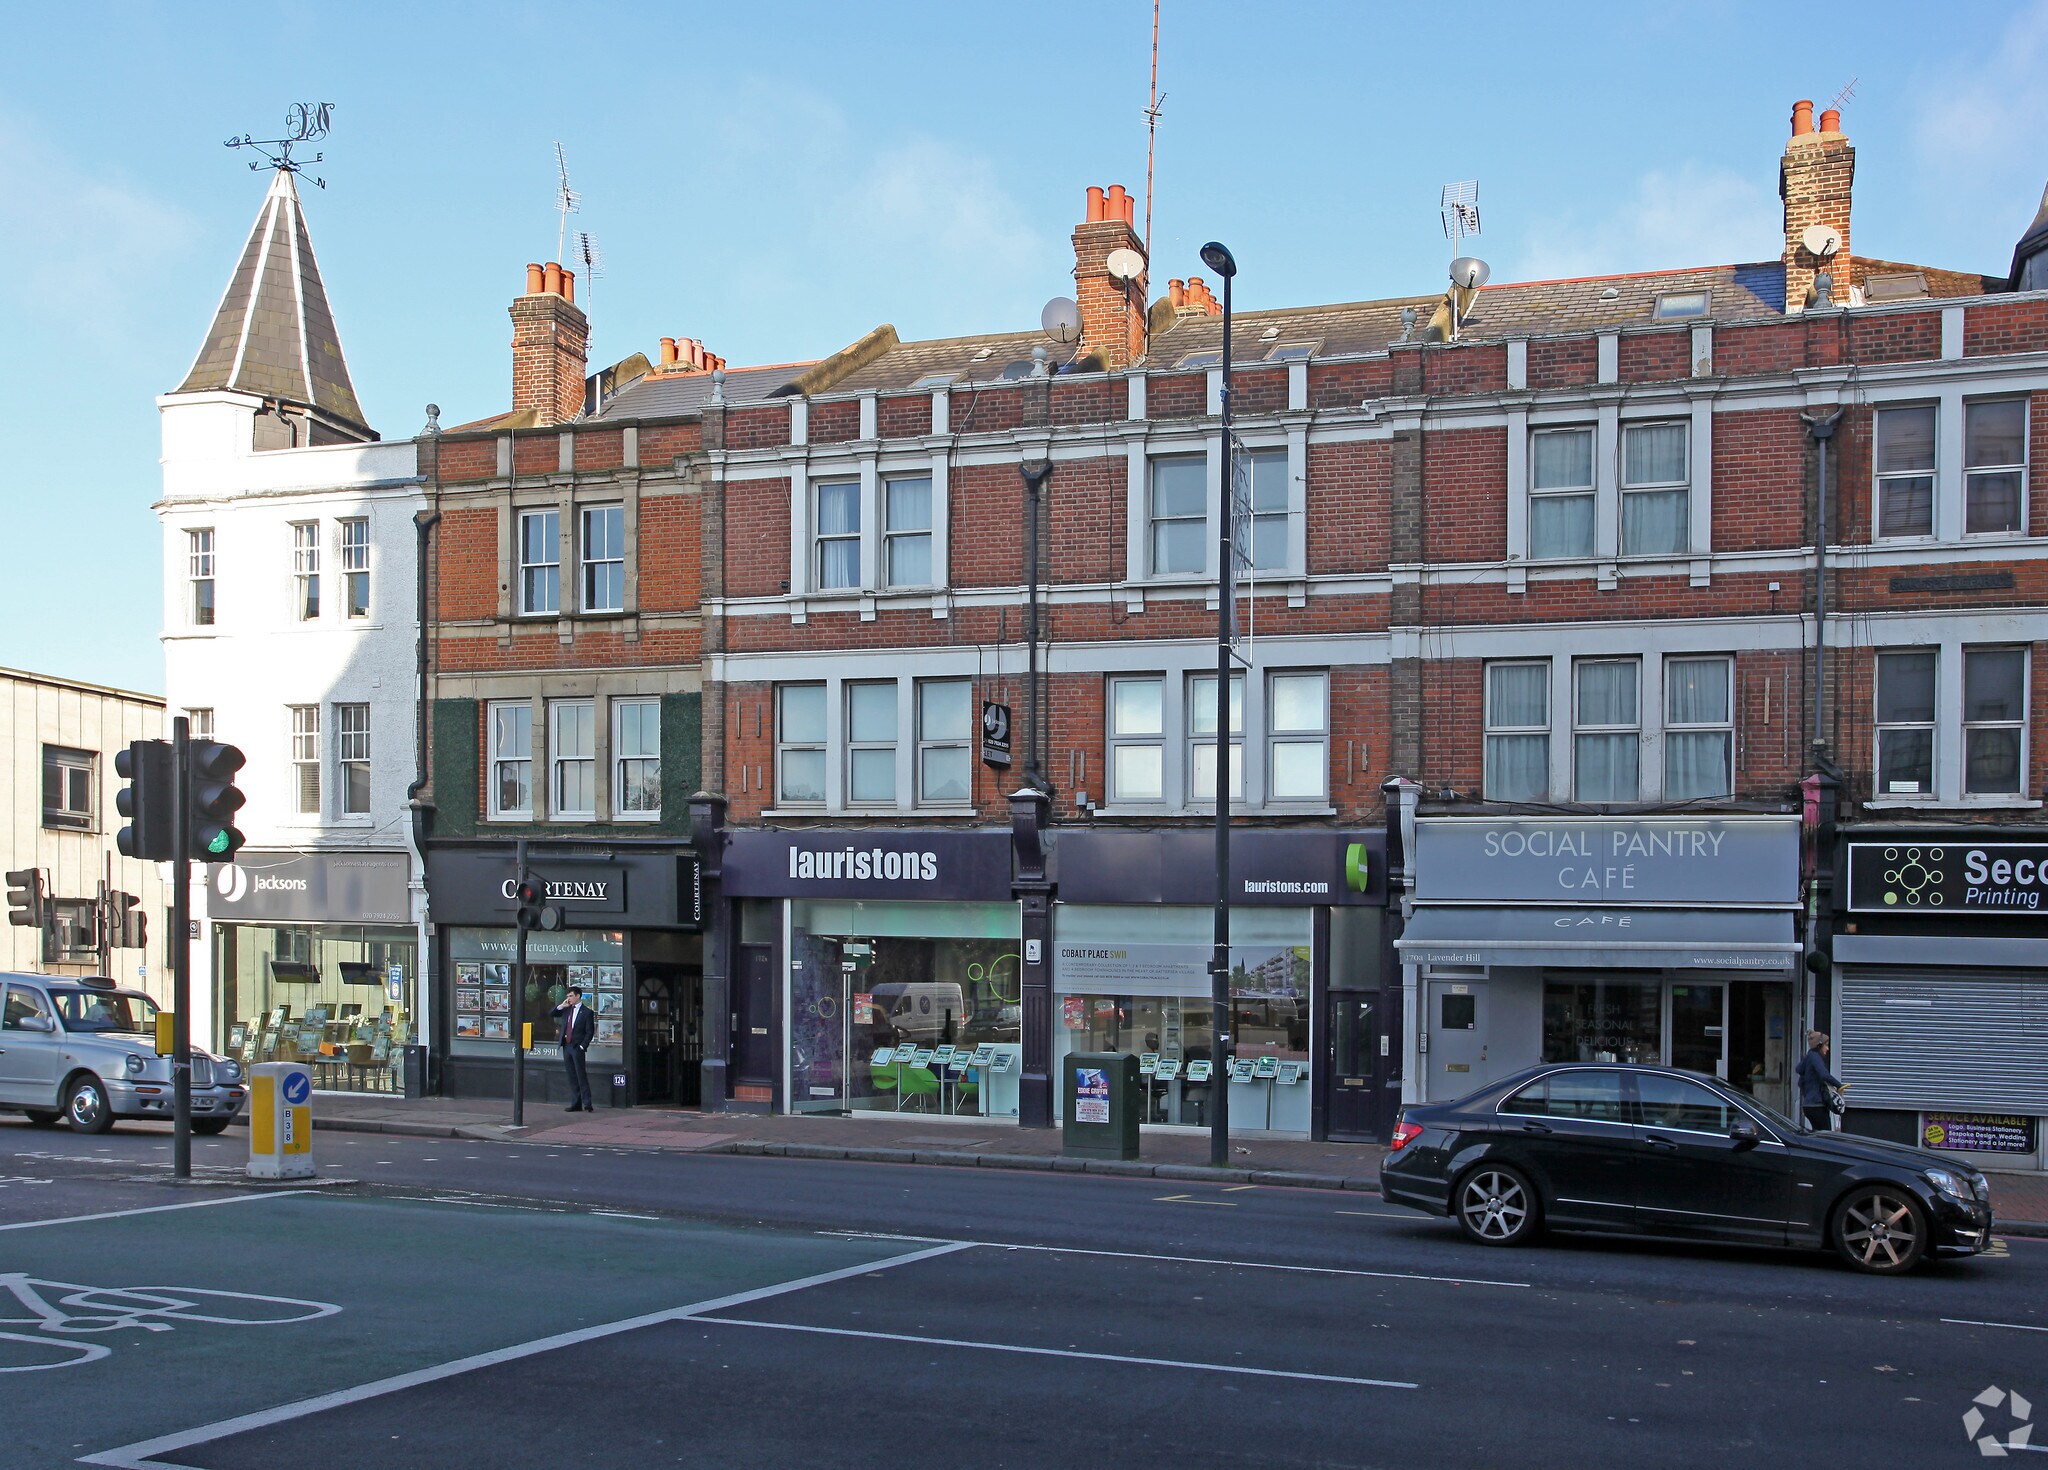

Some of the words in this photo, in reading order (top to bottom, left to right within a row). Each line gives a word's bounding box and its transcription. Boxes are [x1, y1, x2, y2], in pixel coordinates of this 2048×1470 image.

[316, 152, 323, 162] E
[249, 161, 258, 172] W
[317, 177, 326, 190] N
[1485, 831, 1592, 857] SOCIAL
[1613, 831, 1726, 857] PANTRY
[789, 846, 938, 880] lauristons
[1964, 850, 2048, 885] Seco
[1558, 864, 1635, 889] CAFÉ
[253, 874, 307, 893] Jacksons
[501, 879, 607, 899] CRTENAY
[1244, 880, 1328, 893] lauristons.com
[693, 861, 701, 921] COURTENAY
[1965, 887, 2040, 909] Printing
[1554, 916, 1631, 928] CAFÉ
[481, 940, 589, 956] www.crtenay.co.uk
[1062, 949, 1086, 958] COBALT
[1088, 949, 1108, 959] PLACE
[1693, 956, 1791, 966] www.socialpantry.co.uk
[1587, 1005, 1620, 1015] FRESH
[1575, 1019, 1633, 1031] SEASONAL
[1576, 1036, 1632, 1047] DELICIOUS
[543, 1048, 557, 1056] 9911
[1928, 1113, 1969, 1122] SERVICE
[1972, 1116, 2027, 1126] AVAILABLE
[1948, 1137, 1977, 1145] Stationery
